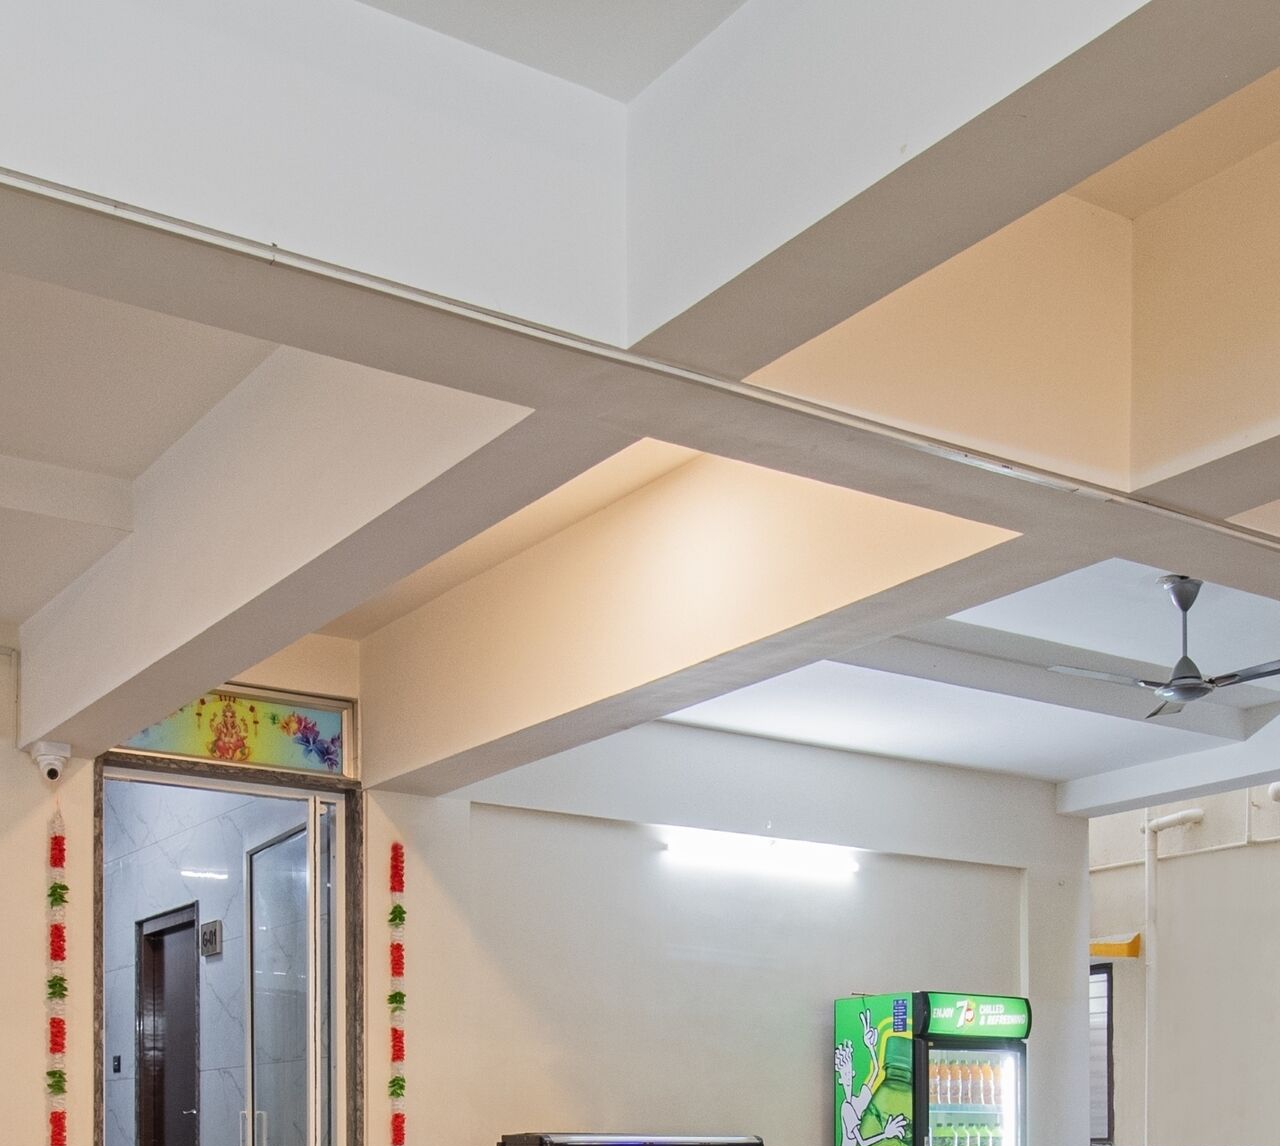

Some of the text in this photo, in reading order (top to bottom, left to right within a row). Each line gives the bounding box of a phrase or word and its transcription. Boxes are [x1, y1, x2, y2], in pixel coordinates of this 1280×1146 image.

[202, 928, 217, 947] G-01
[933, 1008, 953, 1018] ENJOY
[979, 1004, 1004, 1014] CHILLED
